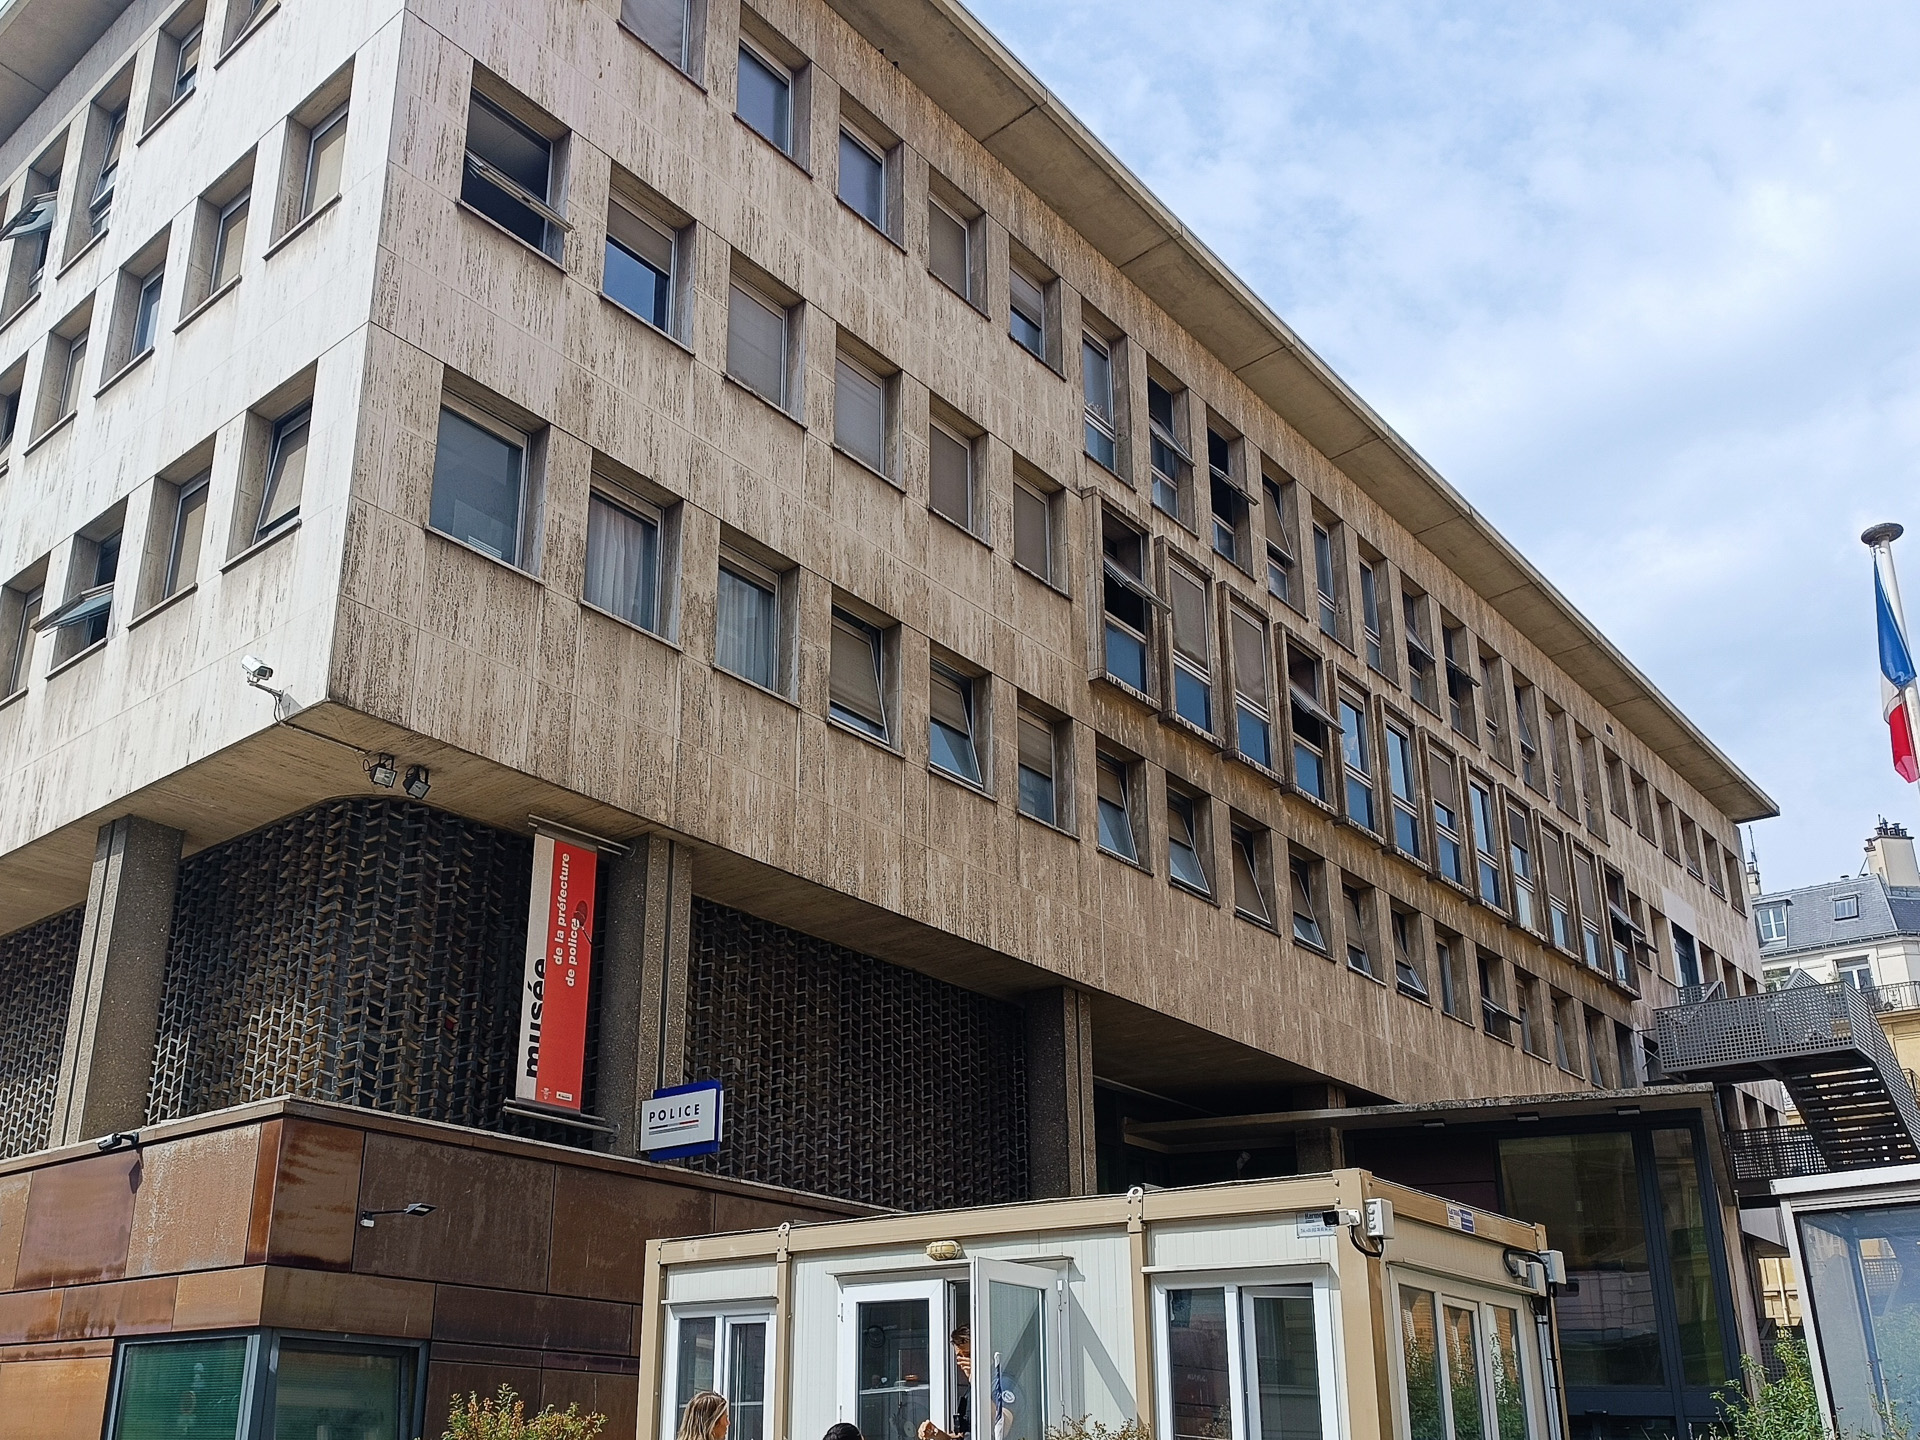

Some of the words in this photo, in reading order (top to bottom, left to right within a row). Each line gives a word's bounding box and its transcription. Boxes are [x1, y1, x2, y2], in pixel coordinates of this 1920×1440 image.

[557, 853, 570, 927] préfecture
[554, 930, 564, 943] la
[567, 918, 580, 965] police
[553, 947, 563, 965] de
[565, 968, 575, 987] de
[526, 958, 545, 1078] musée
[649, 1103, 700, 1123] POLICE
